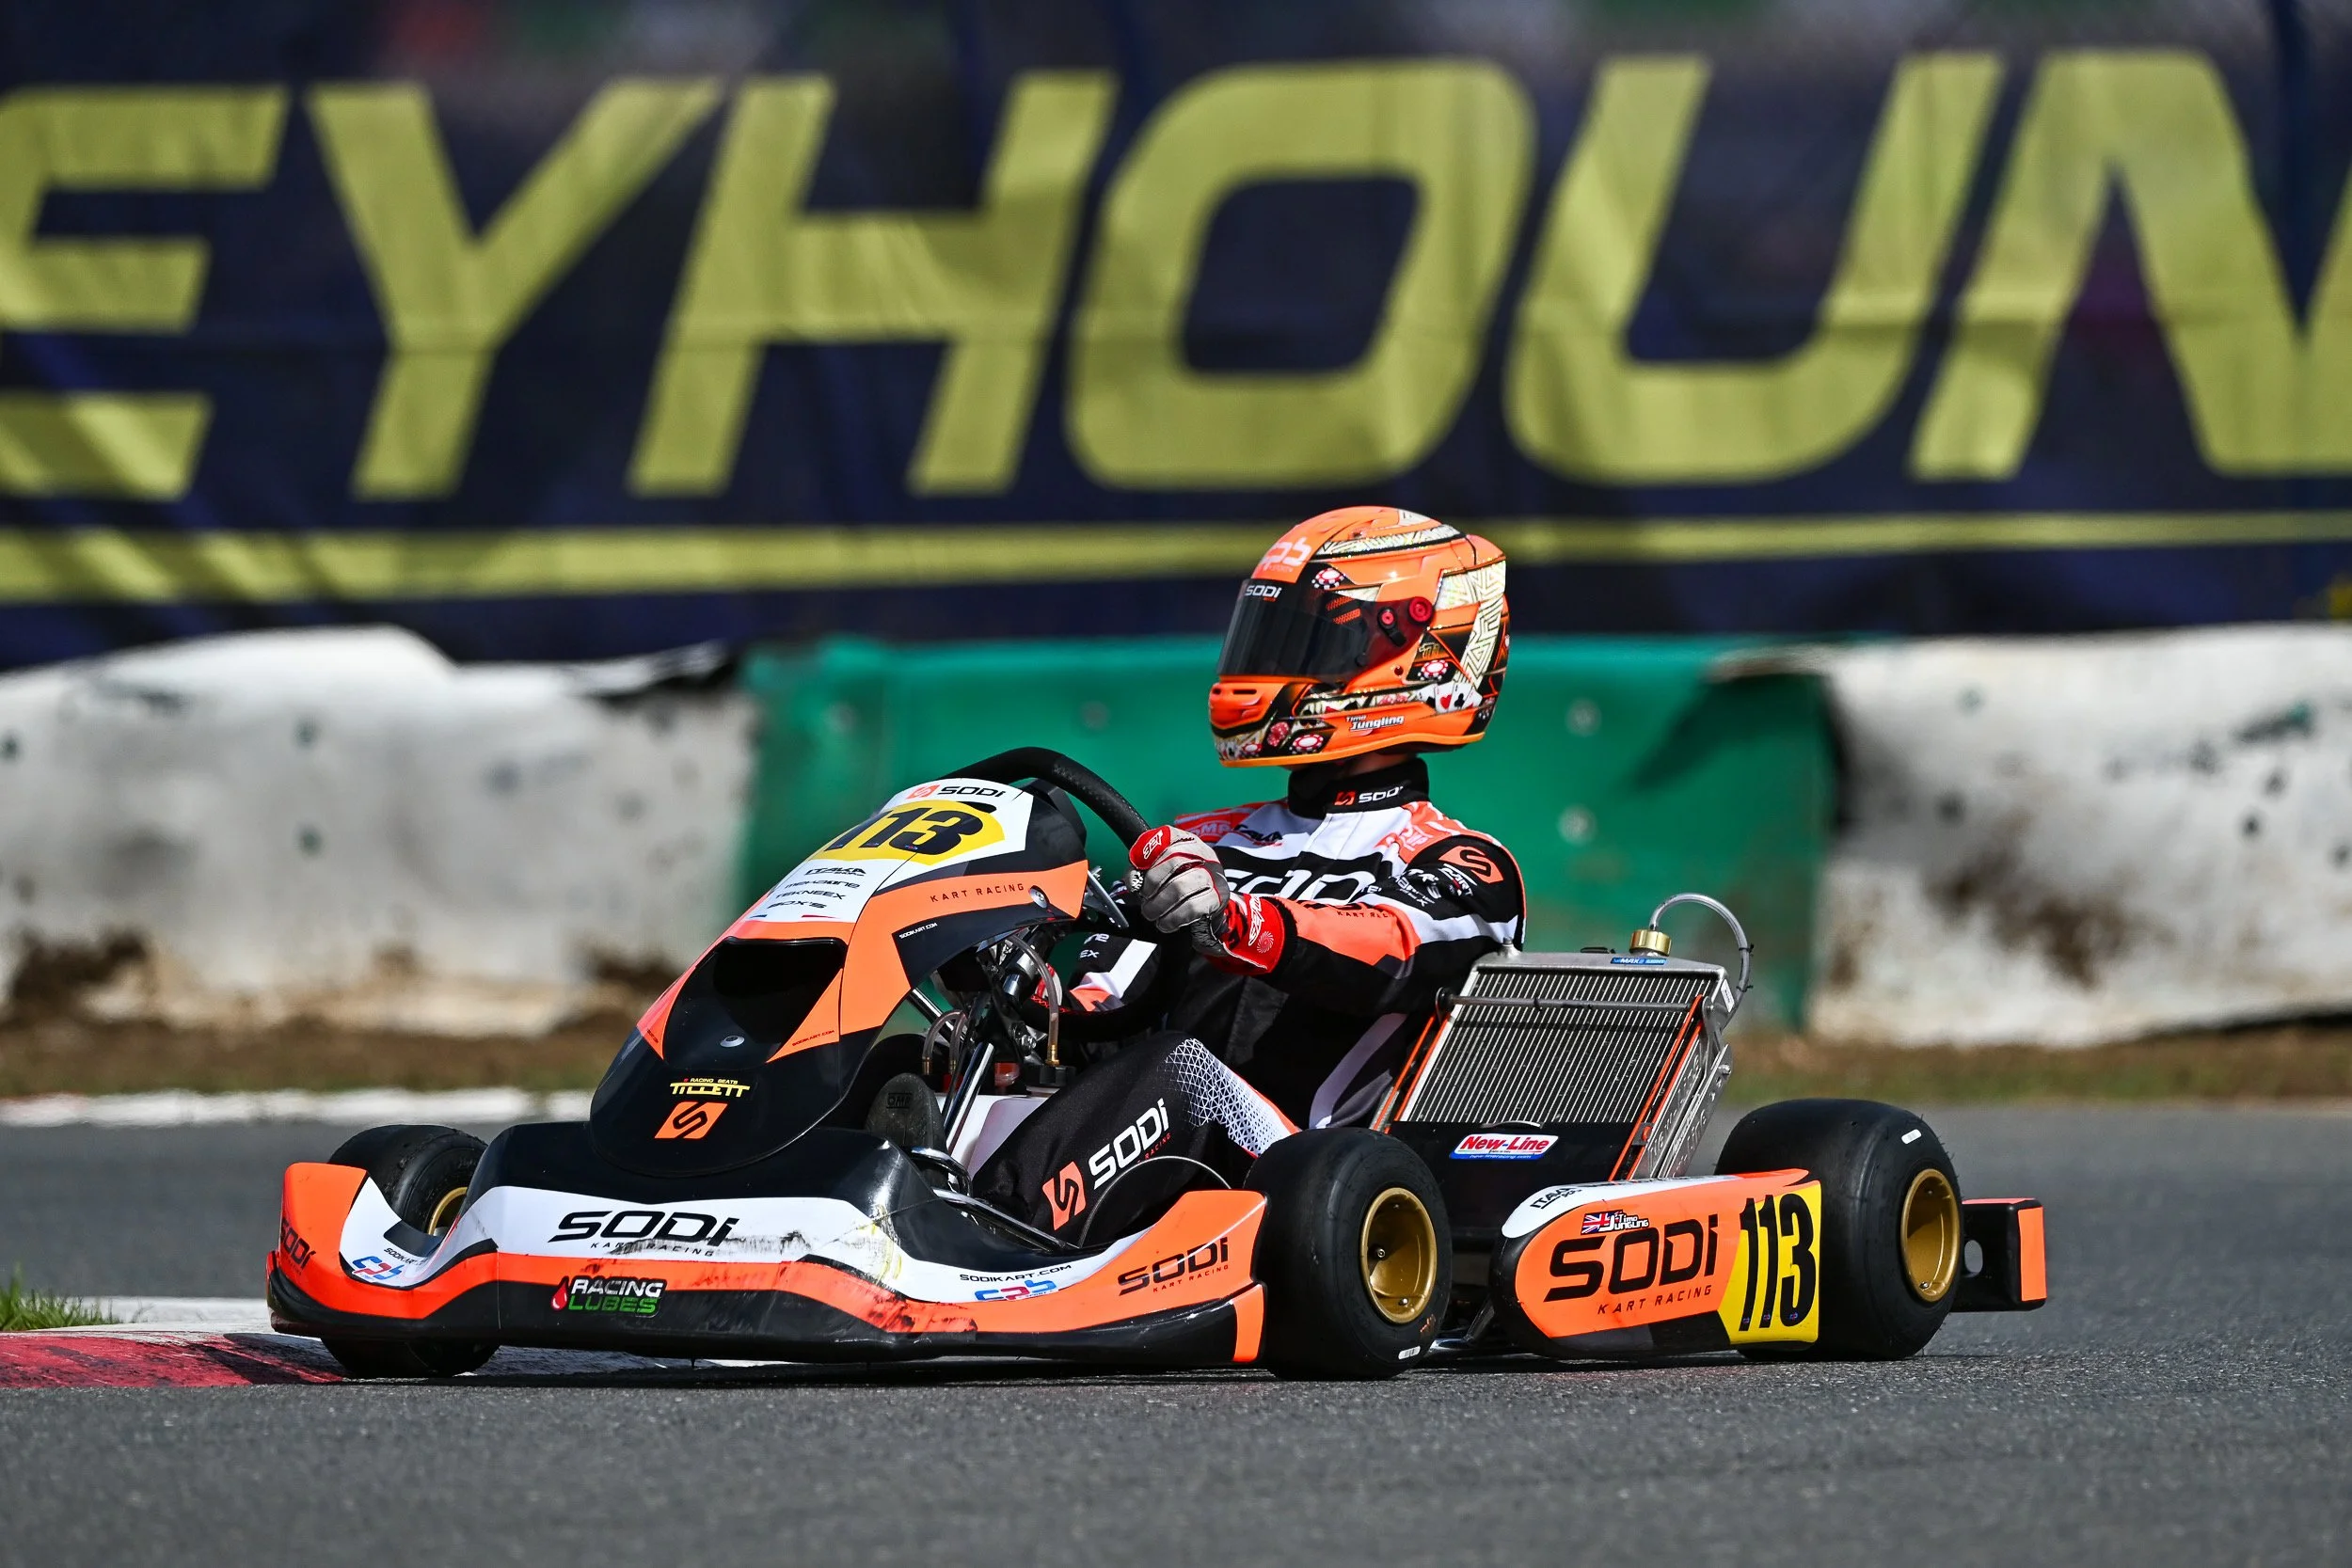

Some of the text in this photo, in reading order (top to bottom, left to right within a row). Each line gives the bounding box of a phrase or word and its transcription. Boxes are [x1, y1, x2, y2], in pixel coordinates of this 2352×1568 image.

[1244, 584, 1281, 598] SODI
[1350, 716, 1405, 731] Jungling
[937, 785, 1007, 798] SODI
[1359, 785, 1403, 803] SOD
[823, 807, 983, 856] 113
[930, 882, 1025, 903] KART RACING
[669, 1083, 751, 1098] TILLETT
[1088, 1098, 1169, 1190] SODI
[1143, 1132, 1172, 1160] RACING
[1459, 1135, 1549, 1150] New-Line
[548, 1211, 740, 1247] SODI
[645, 1243, 715, 1257] RACING
[1543, 1213, 1719, 1302] SODI
[1118, 1236, 1229, 1296] SODI
[1739, 1193, 1816, 1331] 113
[960, 1264, 1072, 1282] SODIKART.COM
[1152, 1264, 1229, 1292] KART RACING
[570, 1278, 664, 1298] RACING
[567, 1295, 663, 1313] LUBES
[1597, 1284, 1712, 1315] KART RACING
